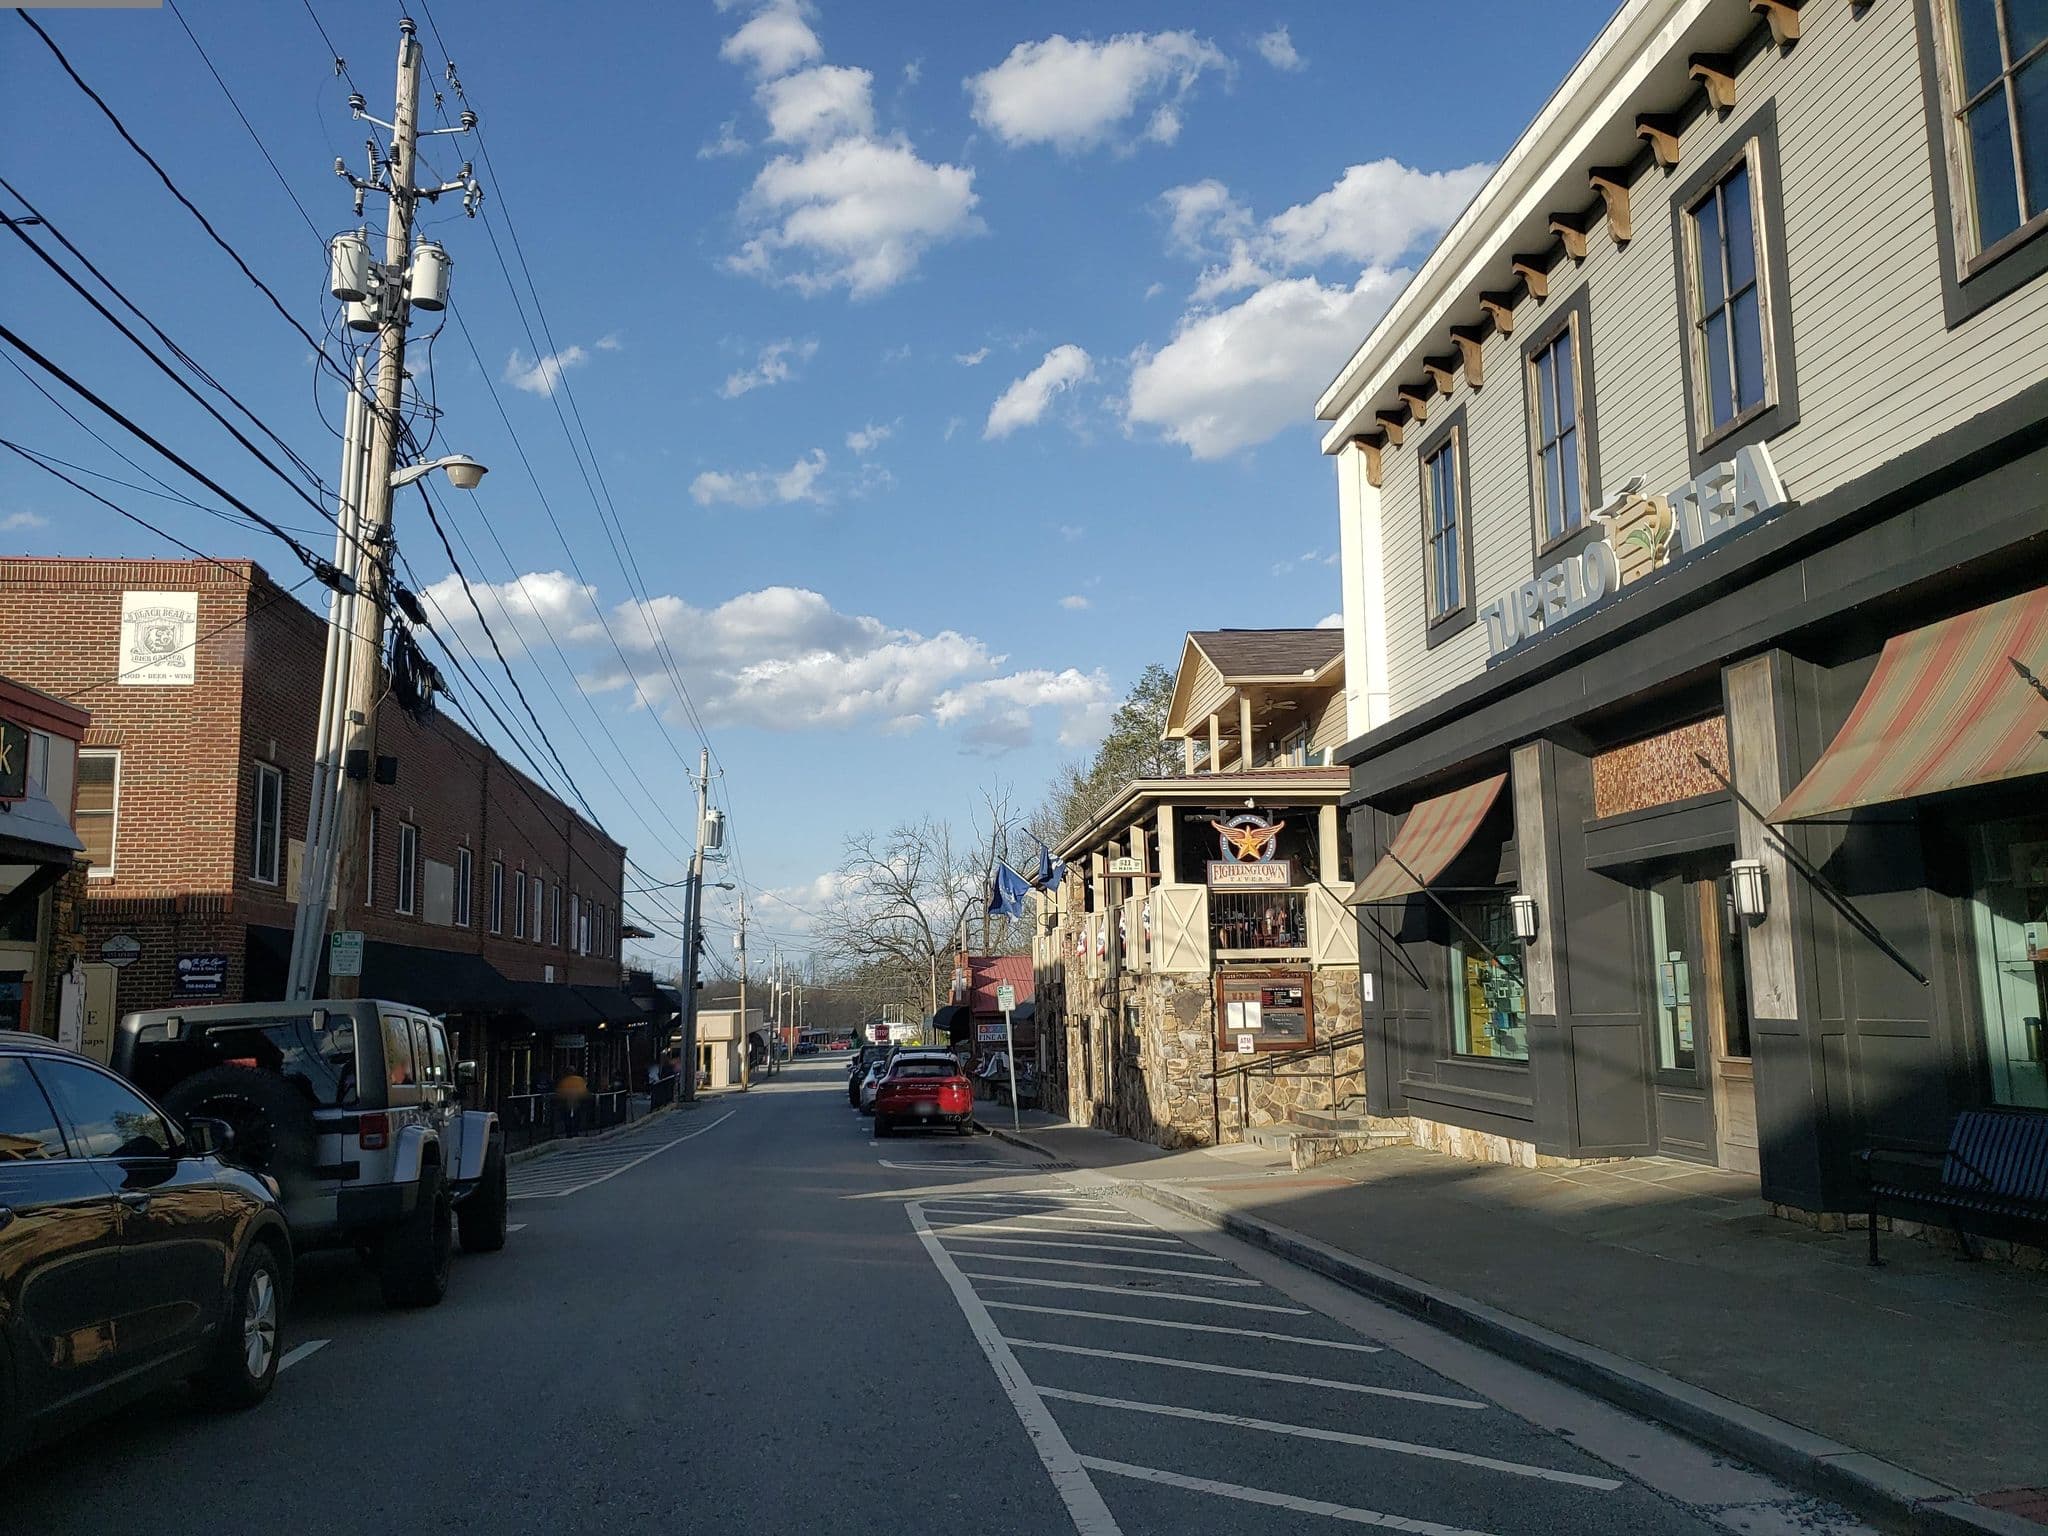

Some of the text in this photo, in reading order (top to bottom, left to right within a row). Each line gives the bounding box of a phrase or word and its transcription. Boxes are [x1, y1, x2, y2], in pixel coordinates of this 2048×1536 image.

[1479, 440, 1788, 657] TUPELO TEA
[134, 608, 185, 620] BLACK BEAR
[1213, 865, 1286, 881] FIGHTINGTOWN
[333, 934, 342, 946] 3
[88, 1011, 98, 1025] E
[876, 1029, 889, 1037] STOP
